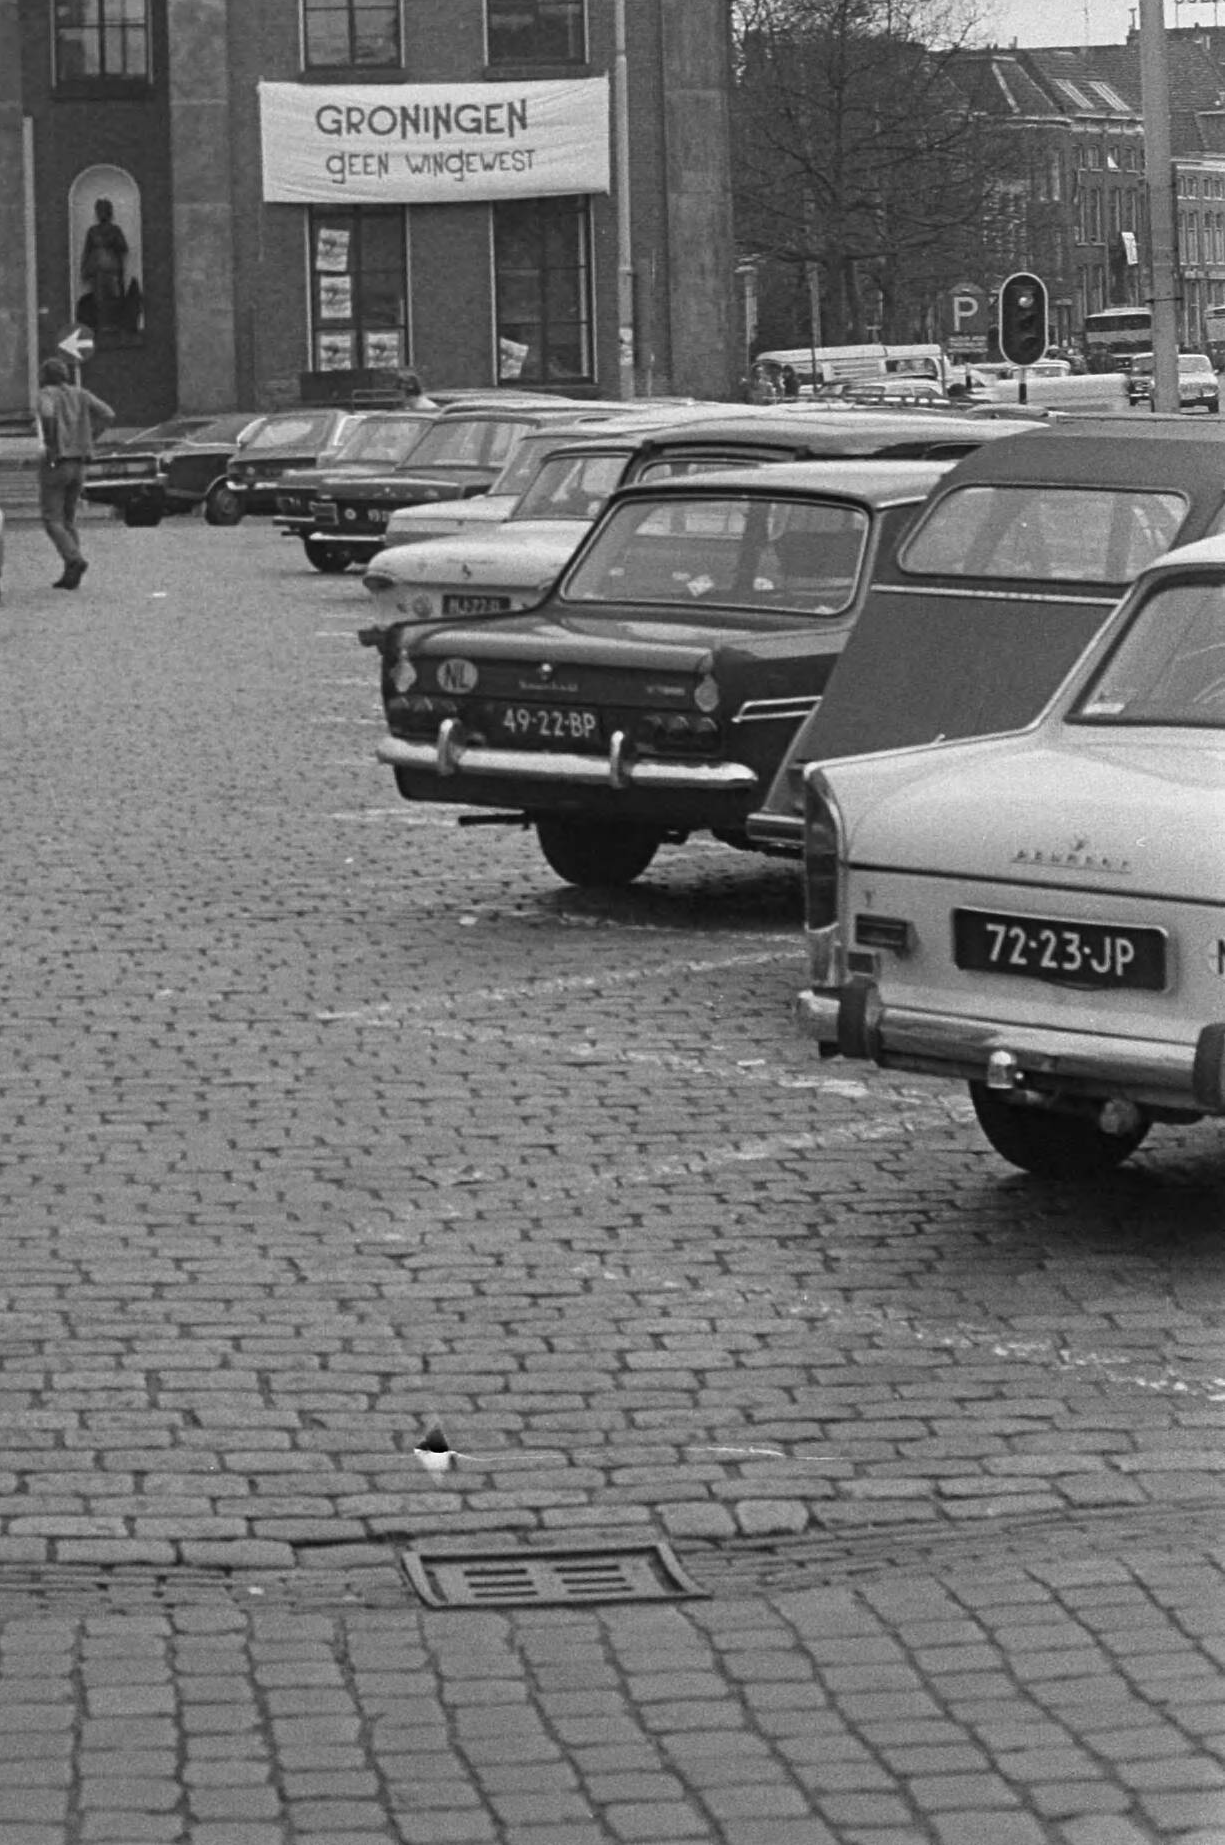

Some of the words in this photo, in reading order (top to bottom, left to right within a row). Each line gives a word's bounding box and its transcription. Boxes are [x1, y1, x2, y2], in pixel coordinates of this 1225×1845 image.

[315, 99, 528, 140] GRONINGEN
[953, 296, 979, 332] P
[445, 662, 470, 690] NL
[503, 709, 596, 738] 49-22-BP
[986, 922, 1135, 976] 72-23-JP
